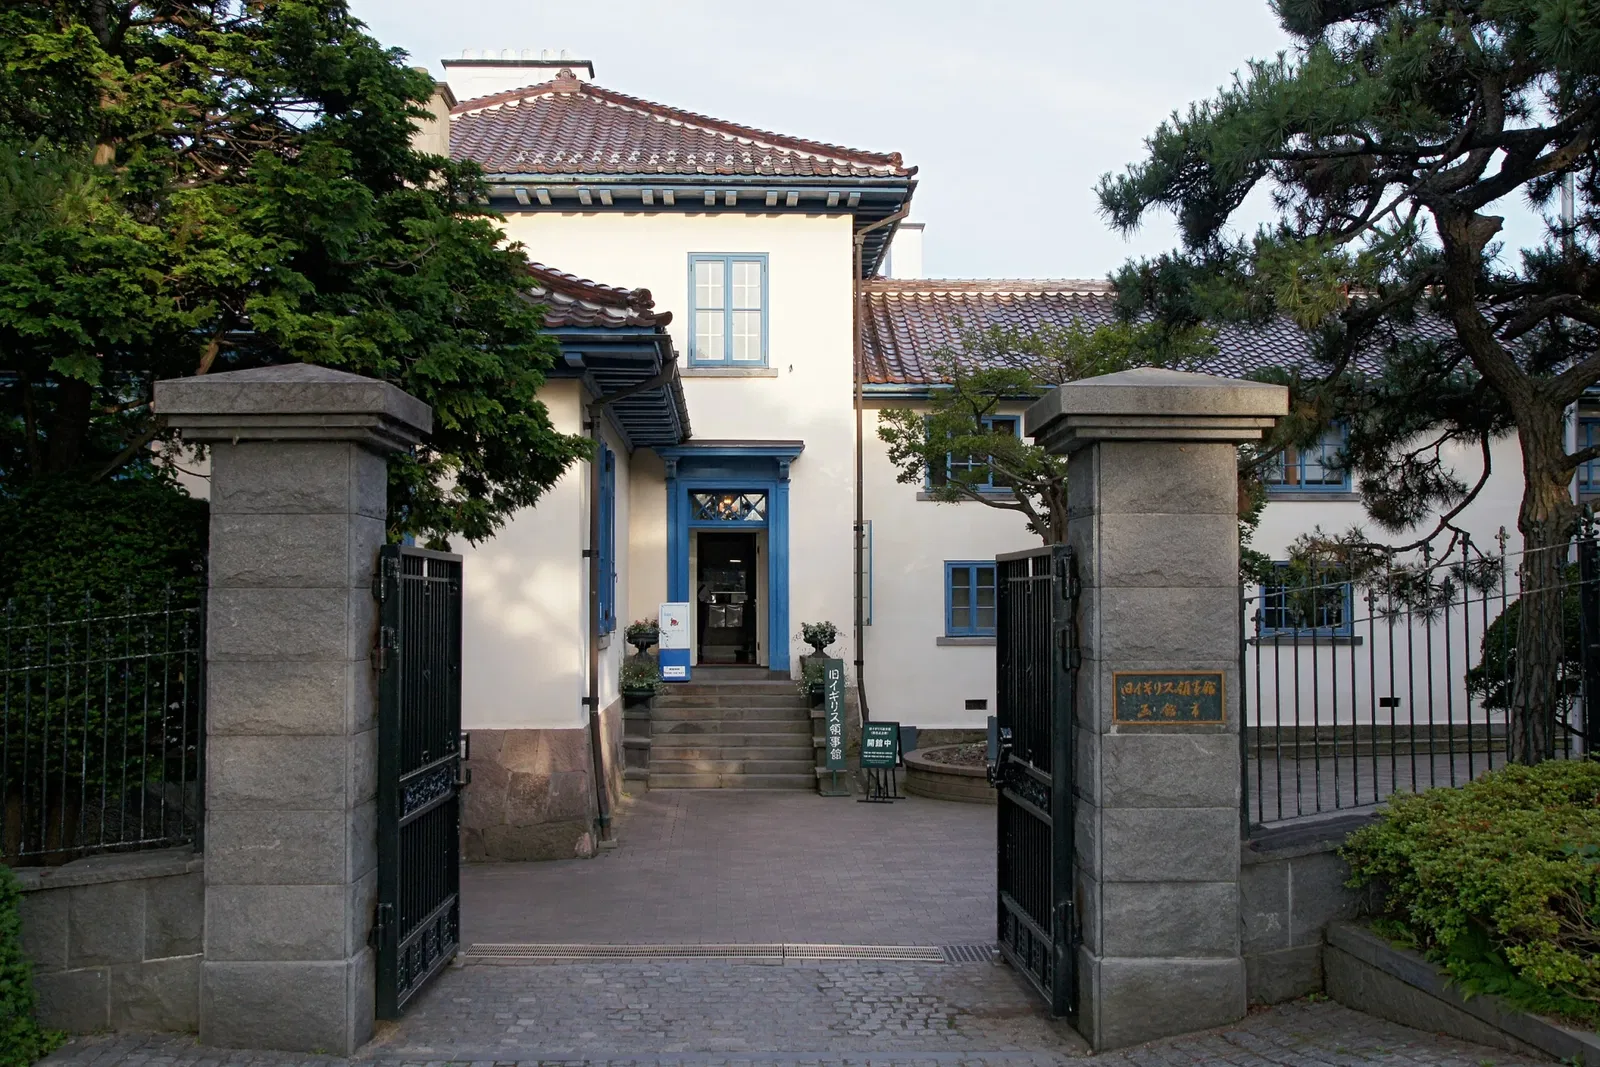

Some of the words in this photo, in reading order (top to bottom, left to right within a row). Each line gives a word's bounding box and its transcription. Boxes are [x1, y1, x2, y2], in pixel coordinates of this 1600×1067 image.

[829, 669, 842, 760] 旧イギリス領事館
[1121, 680, 1216, 696] 旧イギリス領事館
